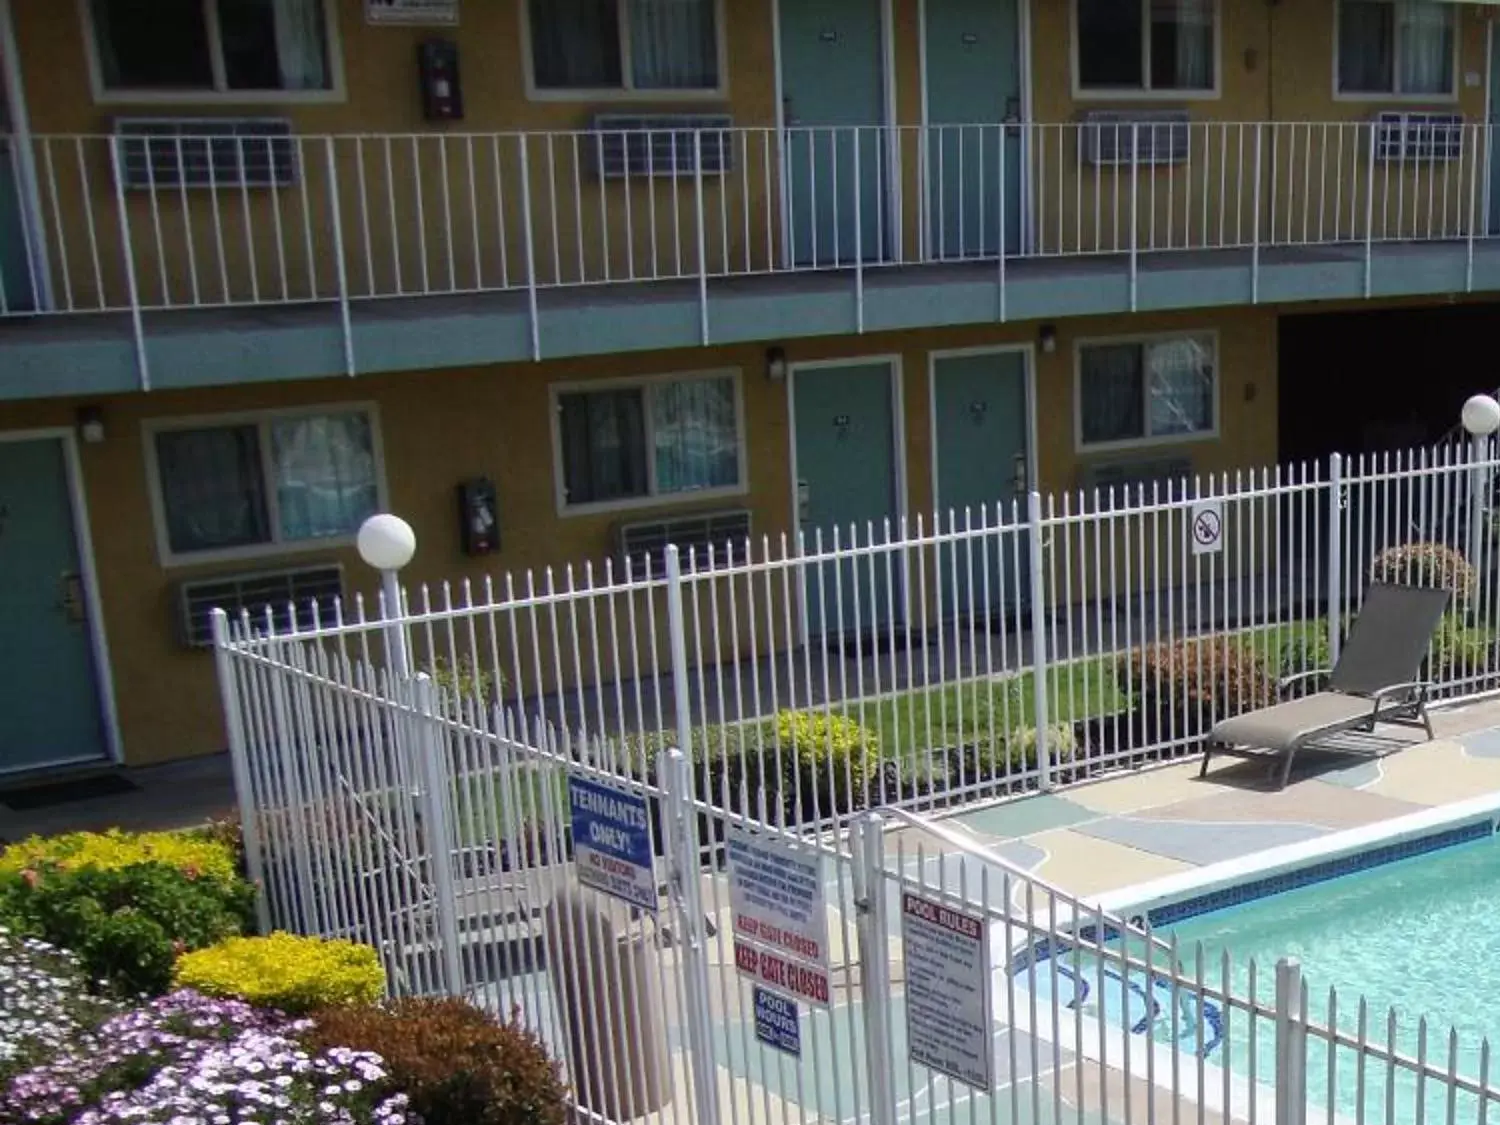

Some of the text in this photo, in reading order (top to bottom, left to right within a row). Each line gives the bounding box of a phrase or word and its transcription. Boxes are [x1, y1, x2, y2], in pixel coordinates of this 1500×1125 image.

[737, 913, 819, 958] KEEP GATE CLOSED
[908, 896, 977, 936] POOL RULES
[735, 941, 829, 1003] KEEP GATE CLOSED
[757, 1005, 799, 1038] HOURS
[759, 989, 790, 1016] POOL
